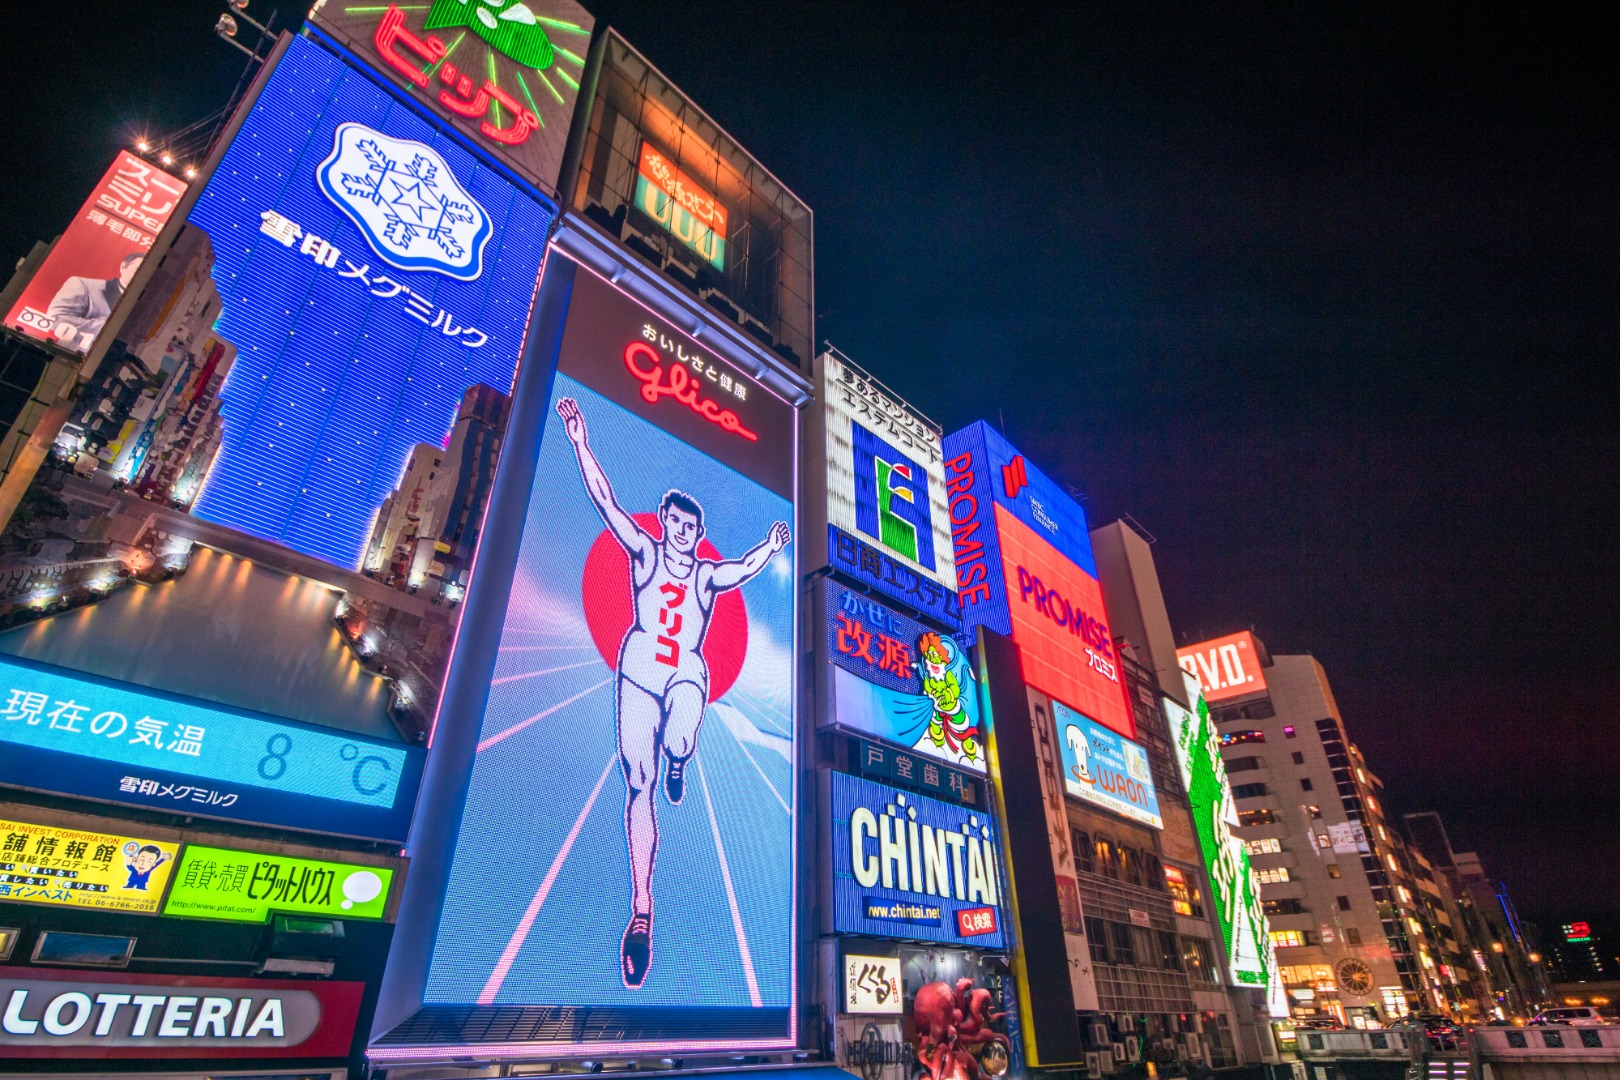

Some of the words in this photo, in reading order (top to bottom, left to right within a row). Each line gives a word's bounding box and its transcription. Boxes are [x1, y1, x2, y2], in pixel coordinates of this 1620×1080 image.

[374, 3, 540, 146] ピップ
[108, 174, 180, 214] ミリ
[259, 209, 488, 348] 雪印メグミルク
[642, 324, 747, 400] おいしさと健康
[624, 341, 758, 442] Glico
[843, 388, 938, 463] エステムコート
[944, 451, 991, 609] PROMISE
[837, 530, 963, 621] 日商エステム
[655, 581, 688, 668] グリコ
[1017, 565, 1113, 660] PROMISE
[835, 614, 912, 679] 改源
[1084, 647, 1119, 684] プロミス
[0, 688, 206, 758] 現在の気温
[257, 732, 292, 781] 8
[867, 745, 964, 794] 戸堂歯科
[118, 775, 239, 808] 雪印メグミルク
[1096, 765, 1149, 808] WAON
[2, 832, 117, 864] 舗情報館
[19, 825, 53, 837] INVEST
[54, 830, 120, 846] CORPORATION
[851, 794, 998, 906] CHINTAI
[77, 897, 92, 905] TEL
[95, 899, 155, 911] 06-6766-2016
[171, 900, 257, 915] http://www.pitat.com/
[247, 860, 336, 906] ピタットハウス
[973, 912, 993, 930] 検索
[2, 988, 286, 1038] LOTTERIA
